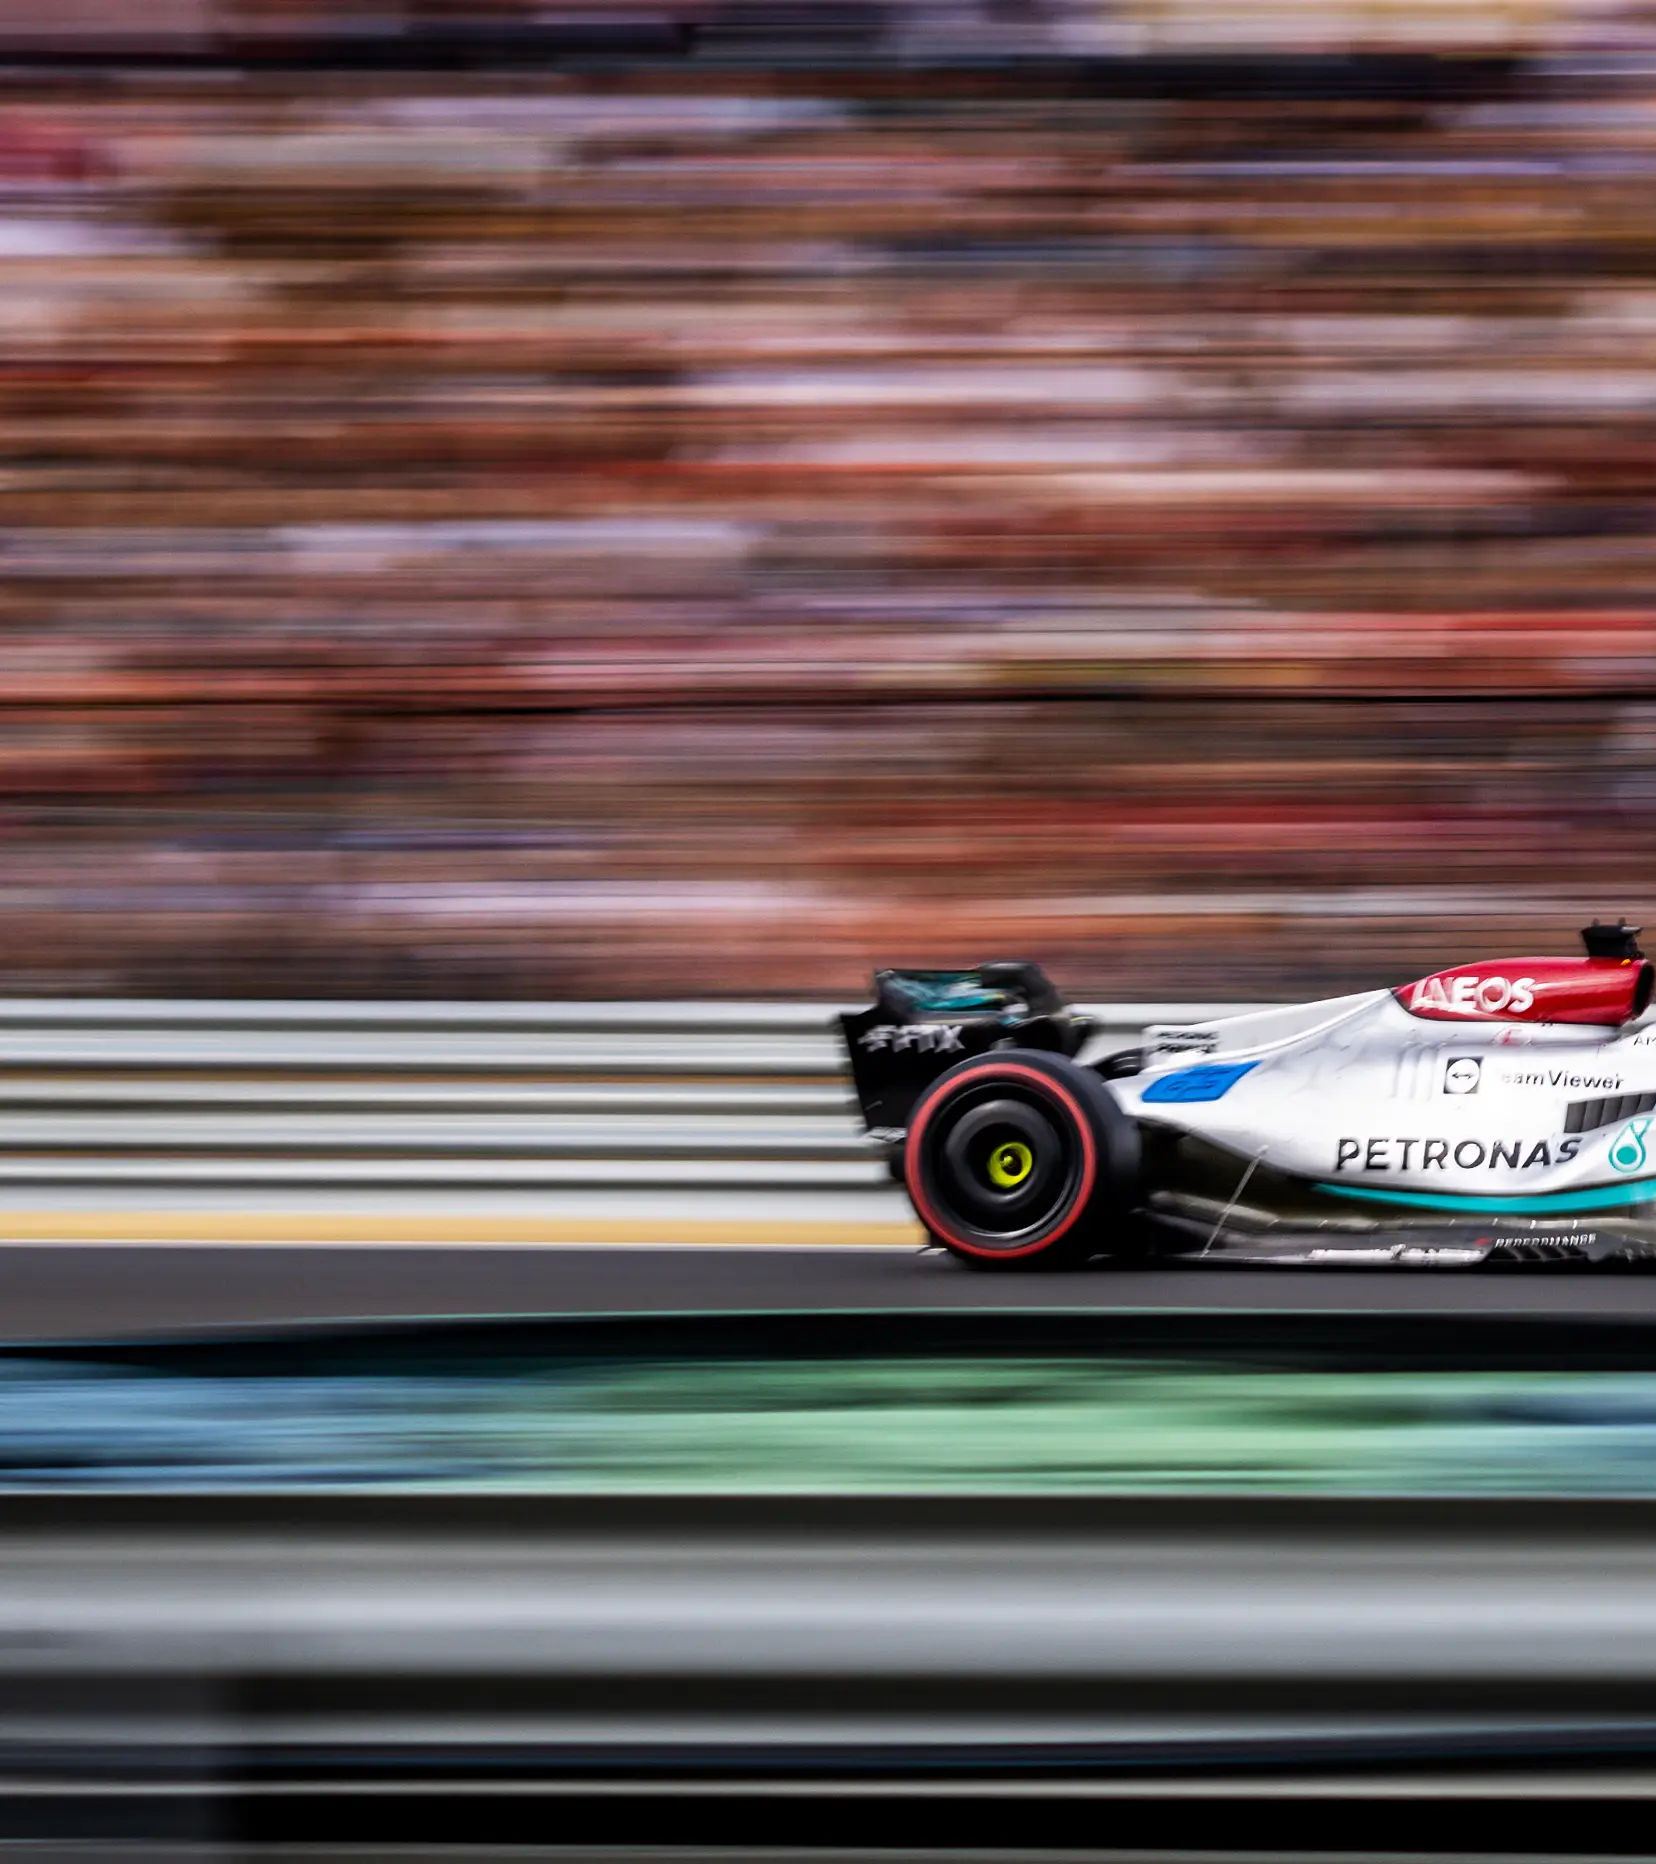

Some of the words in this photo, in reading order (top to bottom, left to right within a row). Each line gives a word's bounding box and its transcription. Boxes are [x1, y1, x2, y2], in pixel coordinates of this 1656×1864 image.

[1410, 976, 1536, 1013] INEOS
[1500, 1069, 1625, 1090] eamViewer
[1336, 1137, 1583, 1171] PETRONAS
